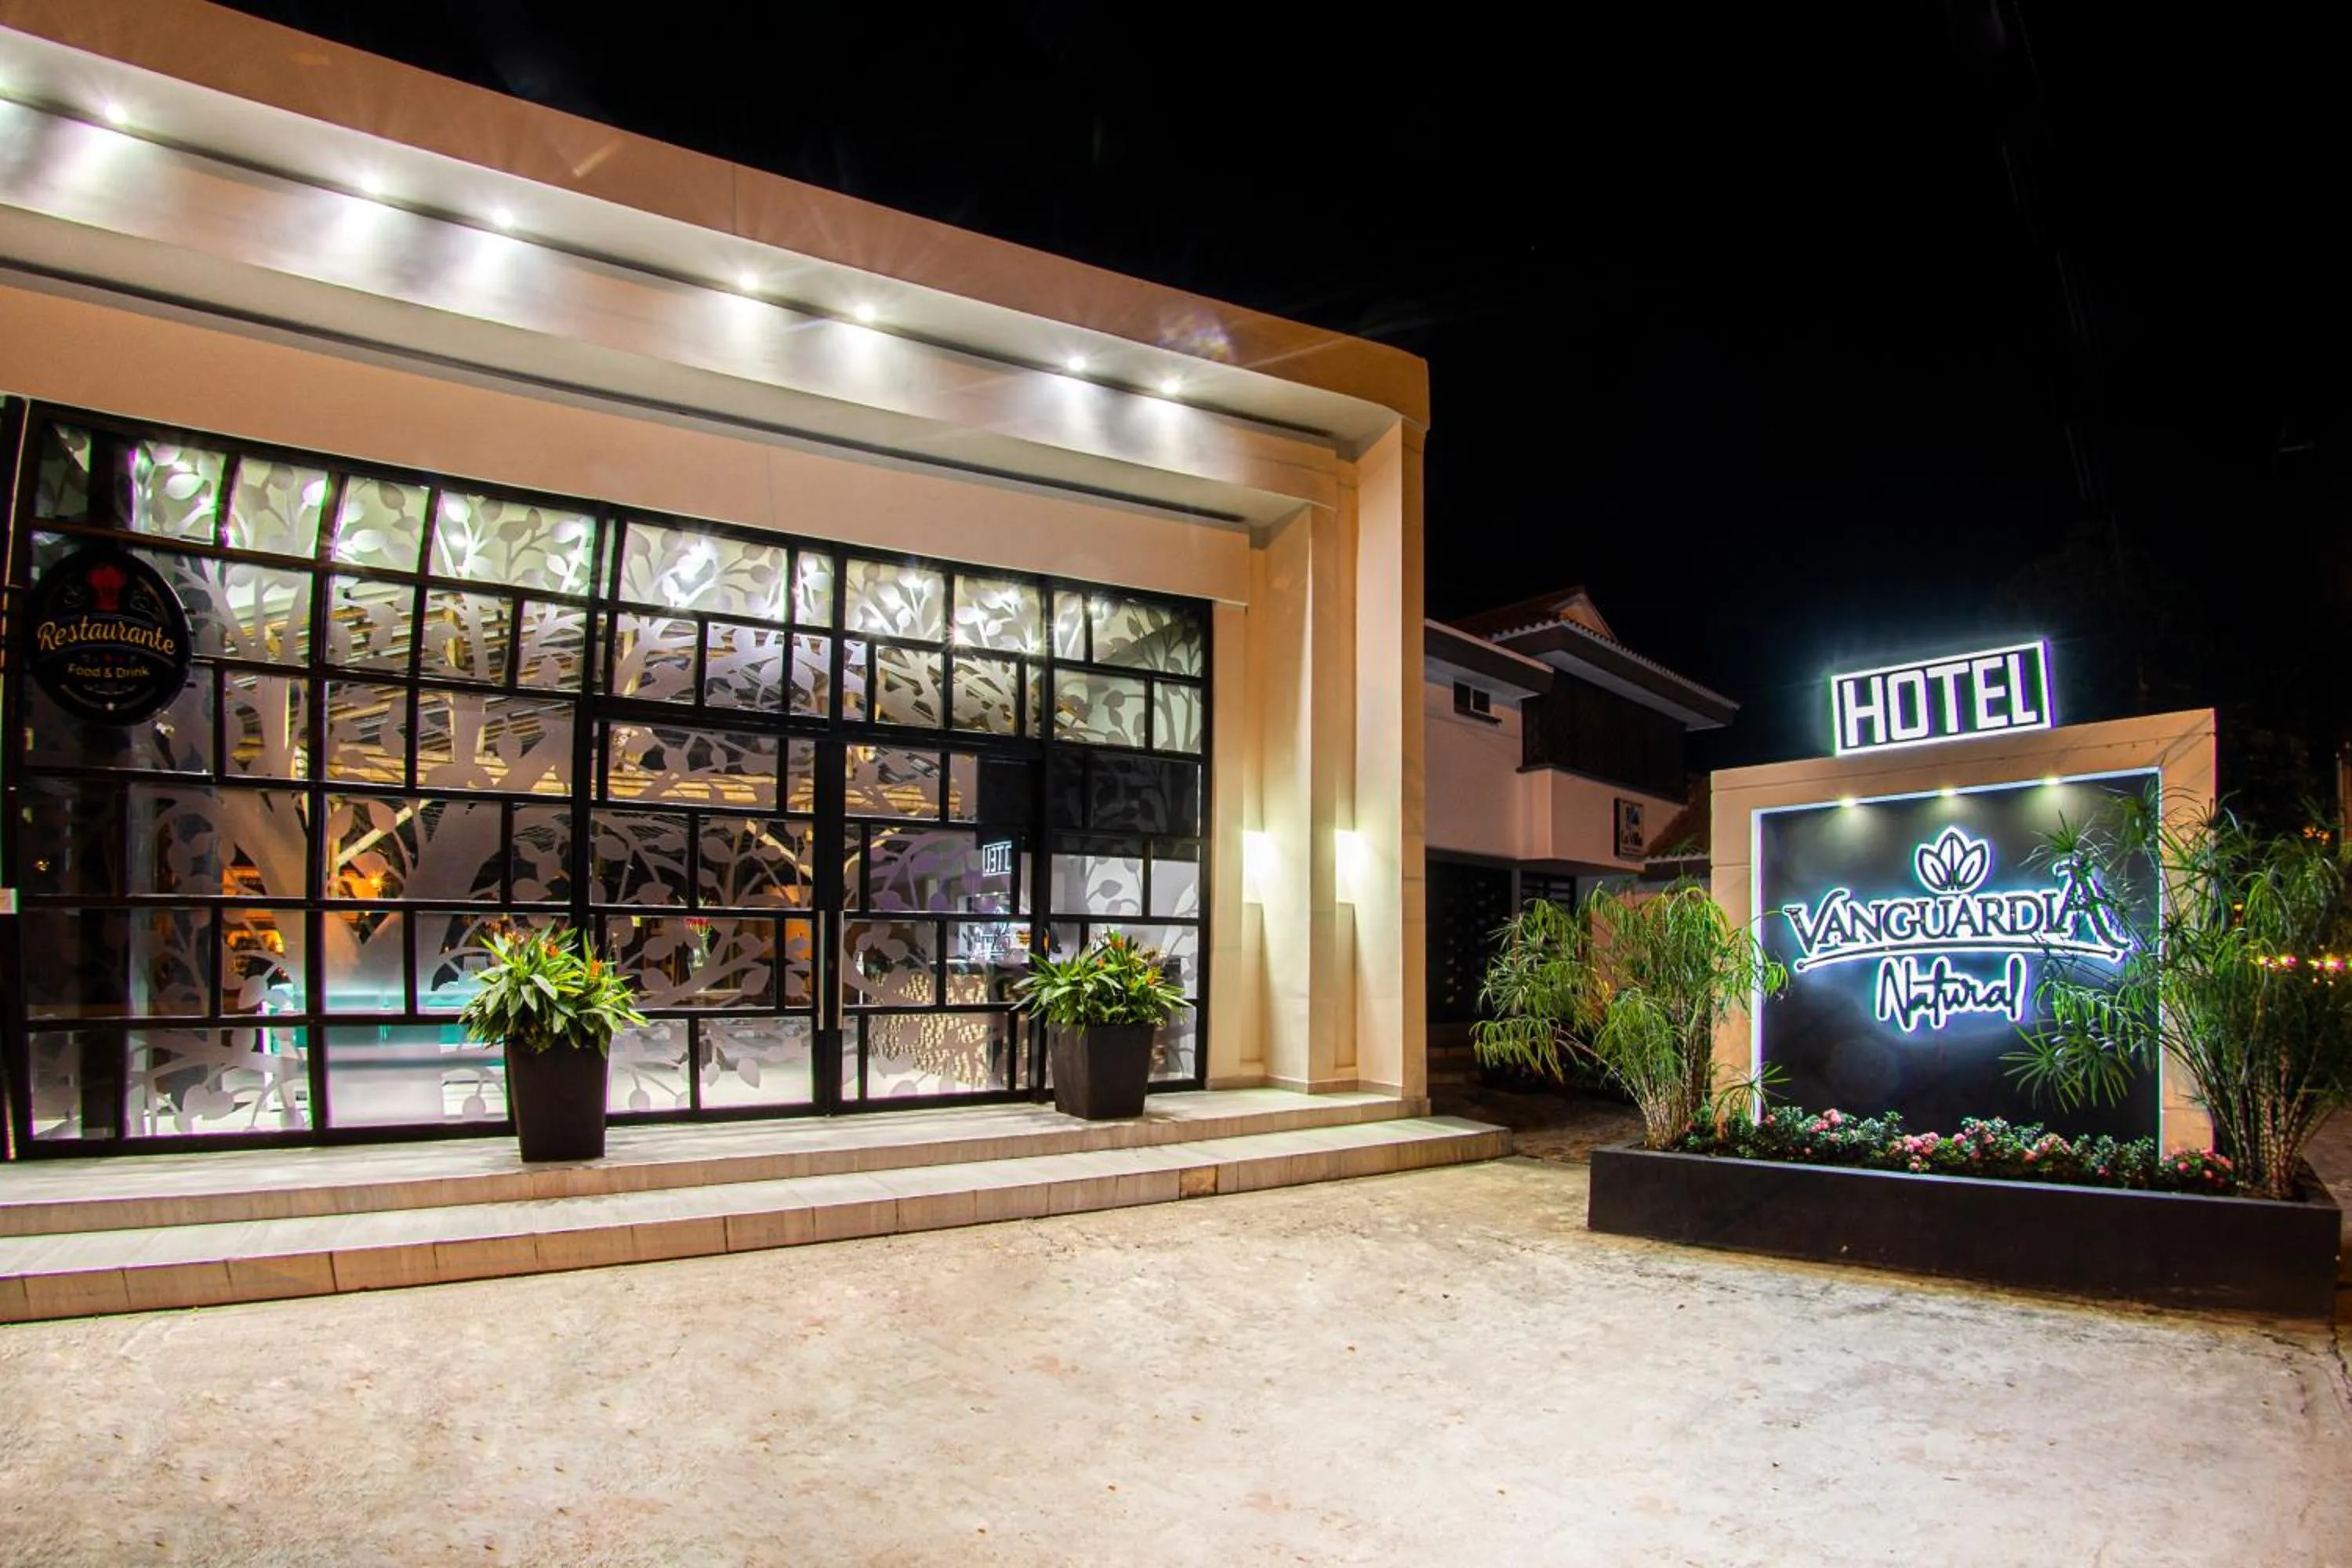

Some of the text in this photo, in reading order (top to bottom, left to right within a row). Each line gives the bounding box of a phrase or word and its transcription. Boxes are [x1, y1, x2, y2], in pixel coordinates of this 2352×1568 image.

[37, 615, 176, 655] Restaurante
[67, 663, 151, 678] Food & Drink
[1842, 652, 2038, 747] HOTEL
[1785, 859, 2133, 954] VANGUARDIA
[1878, 953, 2027, 1029] Natural
